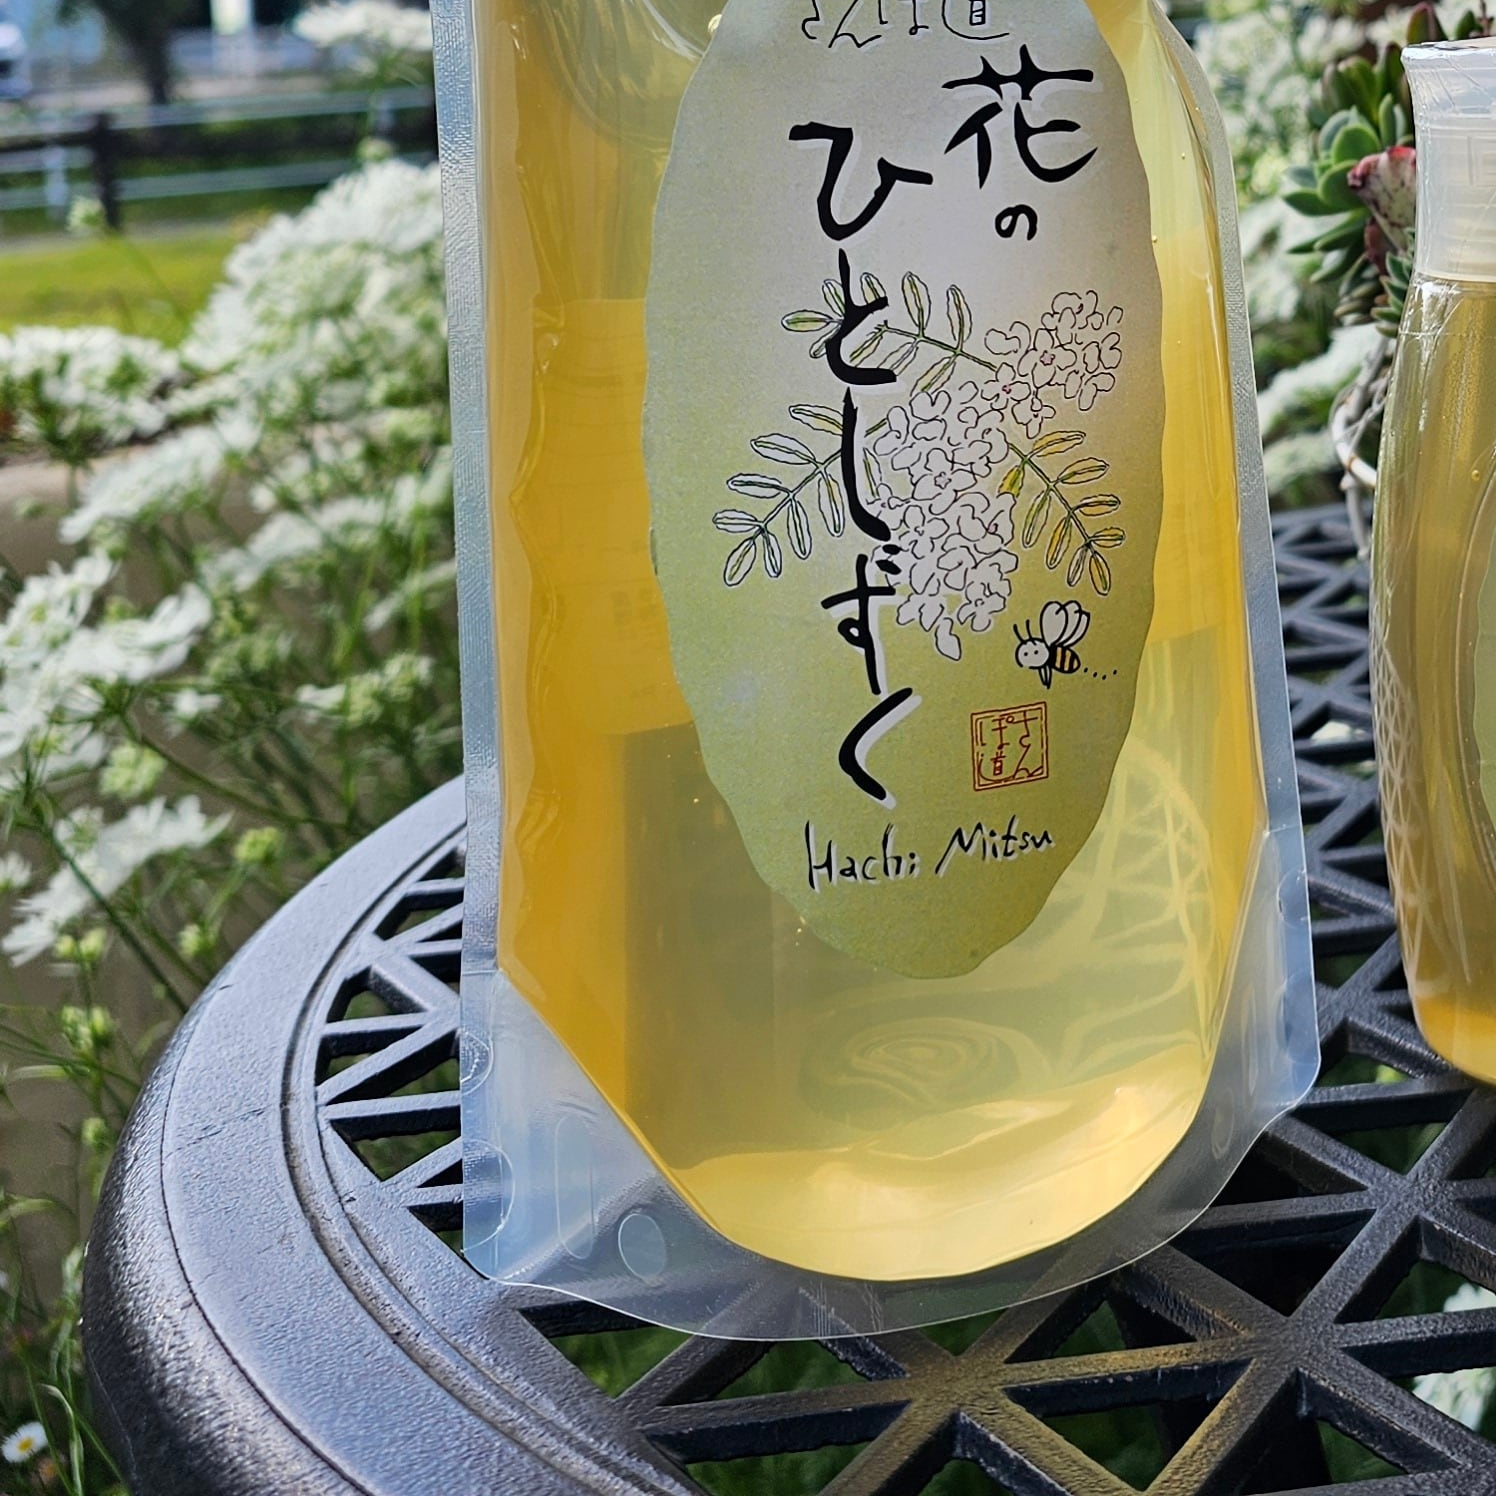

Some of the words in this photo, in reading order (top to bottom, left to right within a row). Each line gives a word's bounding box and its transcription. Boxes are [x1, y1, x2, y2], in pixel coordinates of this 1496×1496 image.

[942, 44, 1098, 241] 花の
[789, 122, 933, 802] ひとしずく
[804, 820, 917, 890] Hachi
[935, 814, 1052, 875] Mitsu
